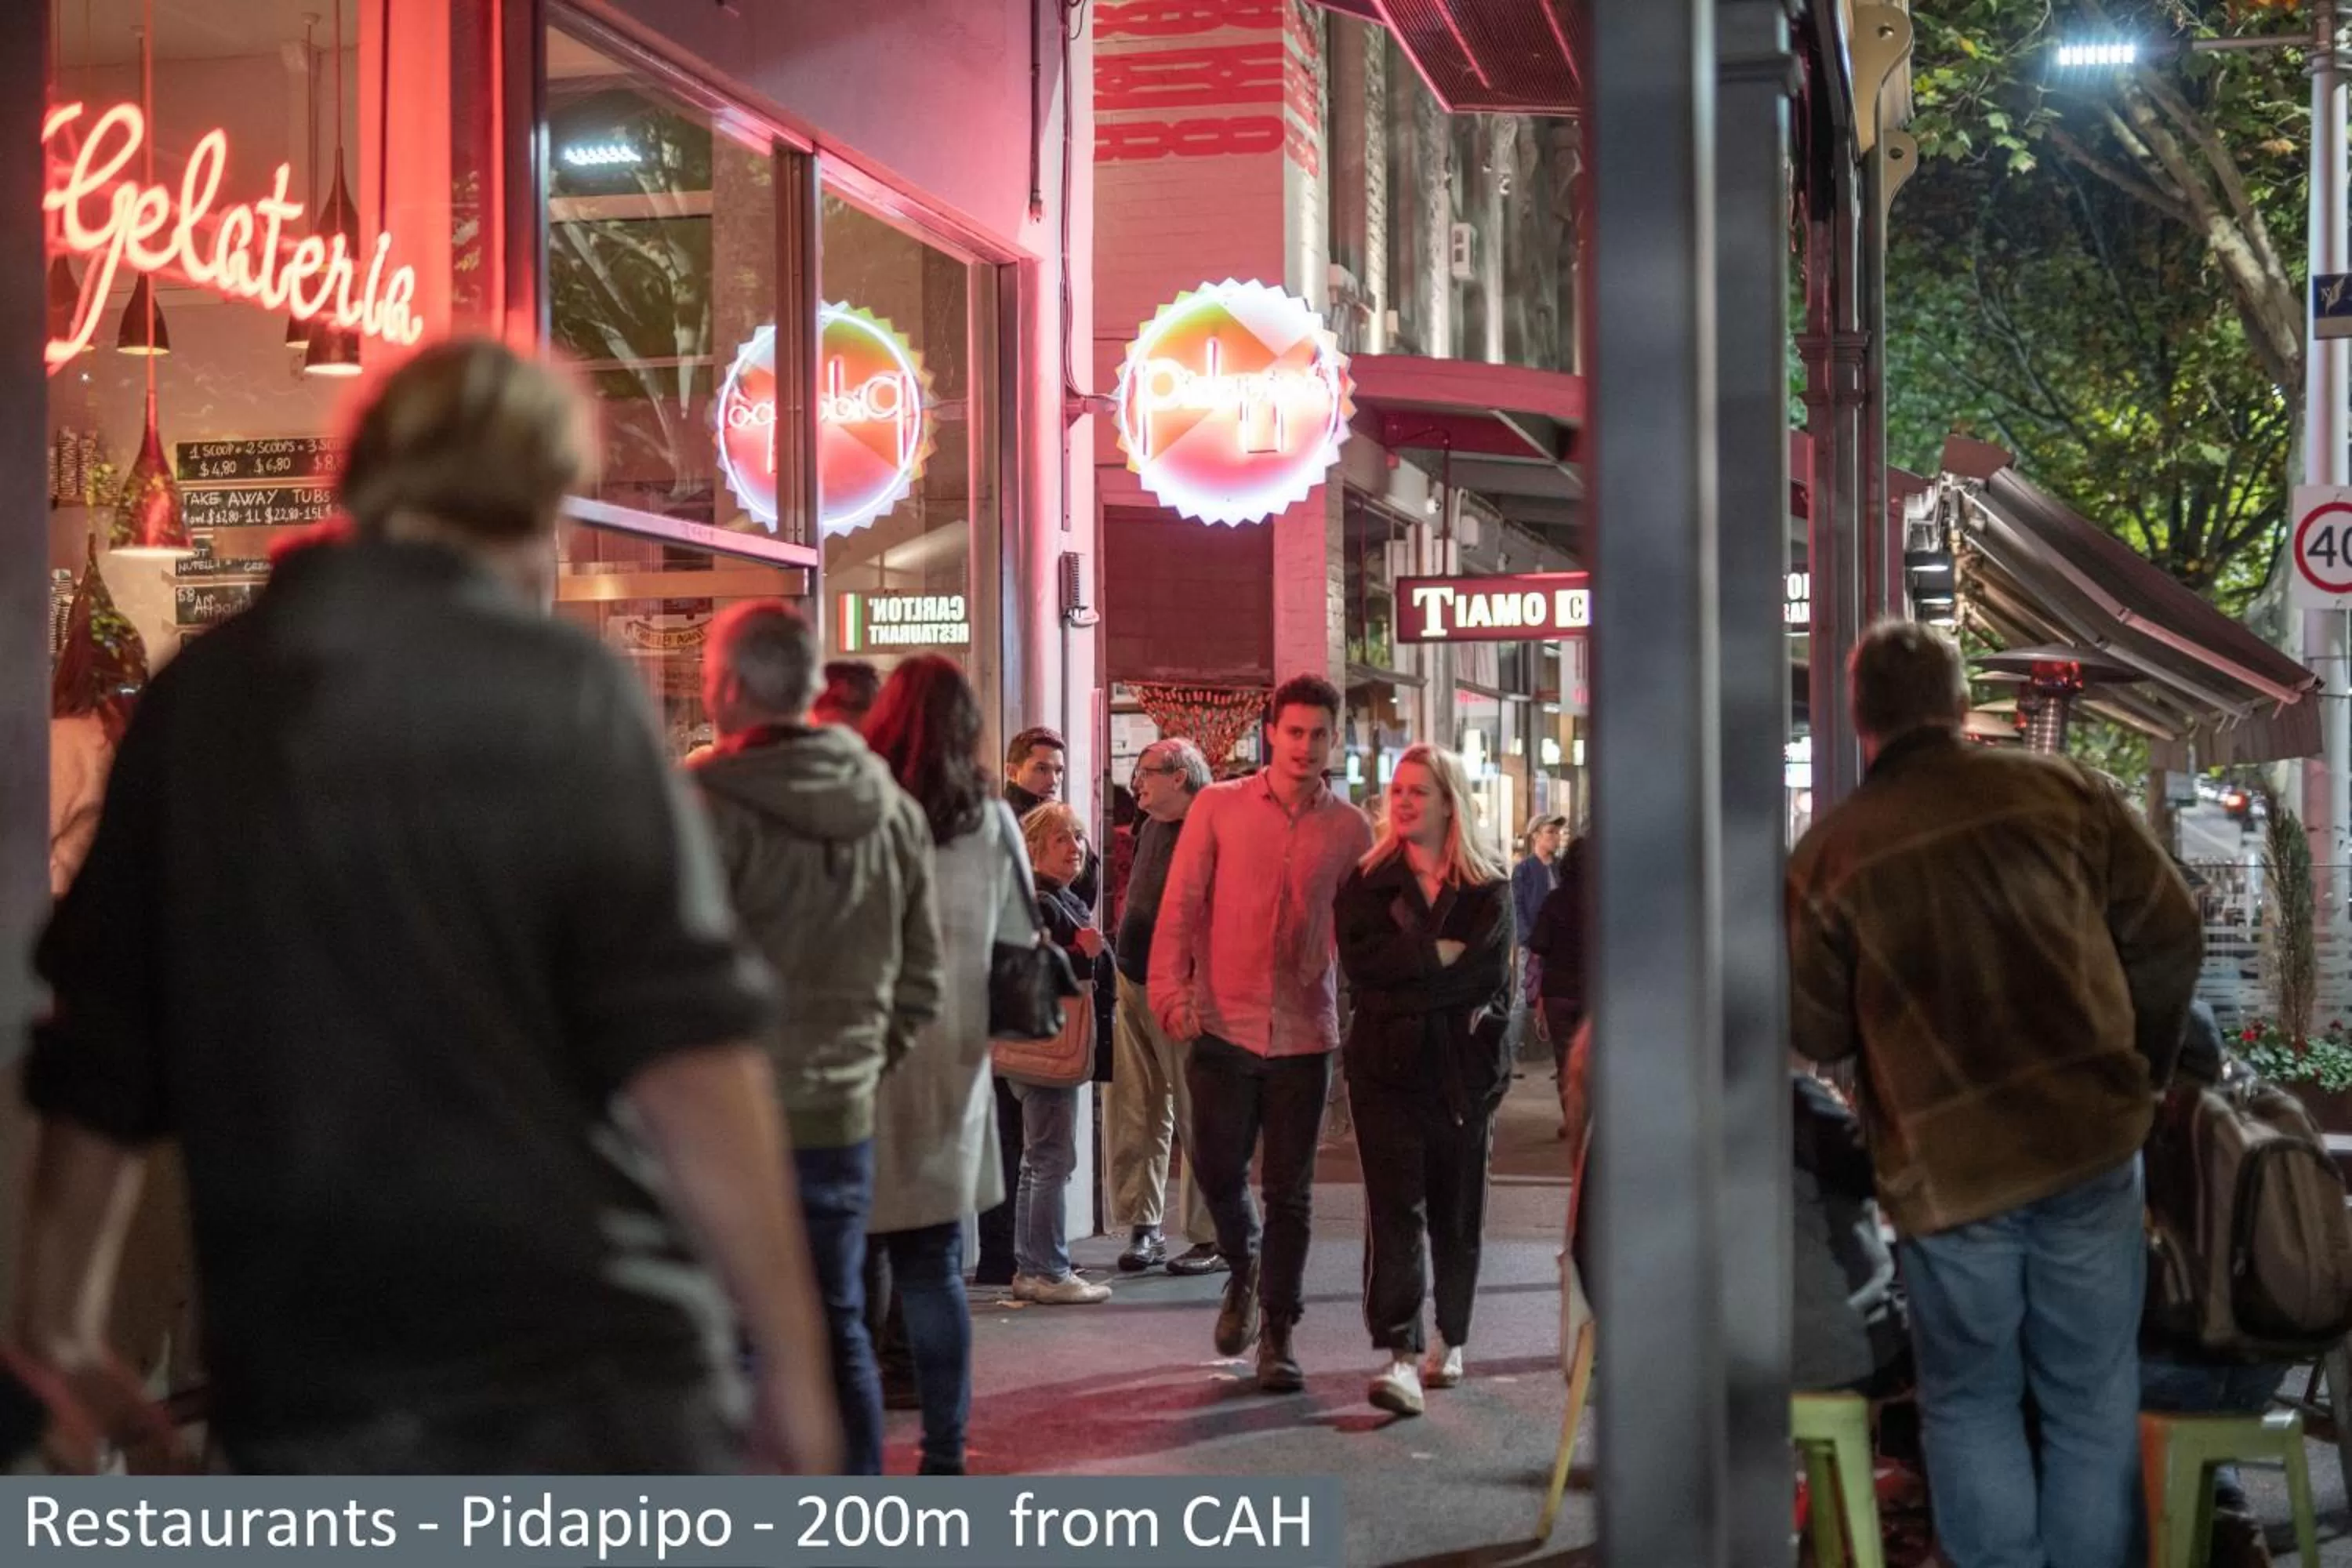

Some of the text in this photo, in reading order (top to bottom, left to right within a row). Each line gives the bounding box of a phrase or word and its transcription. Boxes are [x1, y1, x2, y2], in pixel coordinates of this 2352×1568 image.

[43, 101, 423, 372] Gelateria
[183, 491, 222, 506] TAKE
[227, 488, 278, 508] AWAY
[1412, 586, 1548, 637] TIAMO
